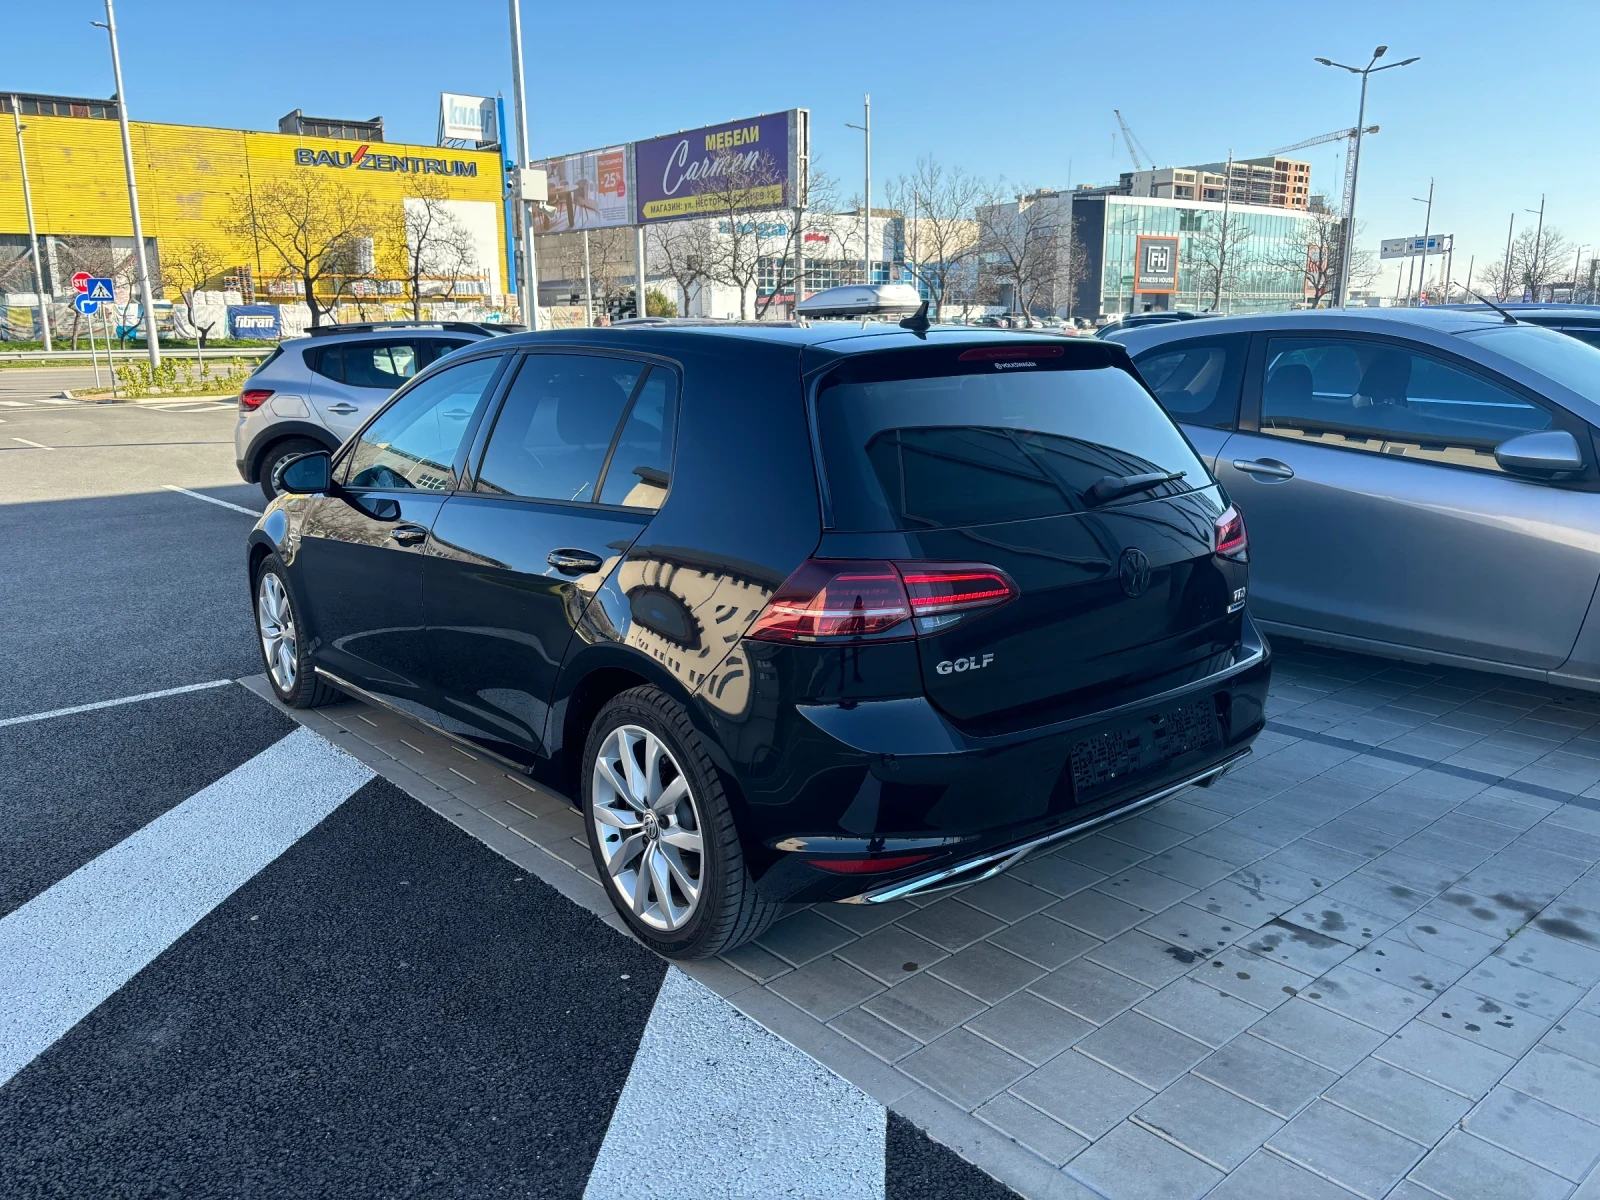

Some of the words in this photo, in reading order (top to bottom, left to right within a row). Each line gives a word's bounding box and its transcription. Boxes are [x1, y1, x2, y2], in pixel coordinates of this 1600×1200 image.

[449, 98, 493, 134] KNAUF
[705, 125, 760, 151] МЕБЕЛИ
[662, 139, 760, 195] Carmen
[650, 203, 683, 214] МАГАЗИН:
[1151, 252, 1166, 267] FH
[74, 279, 88, 287] STO
[234, 315, 275, 328] fibran
[936, 652, 994, 675] GOLF
